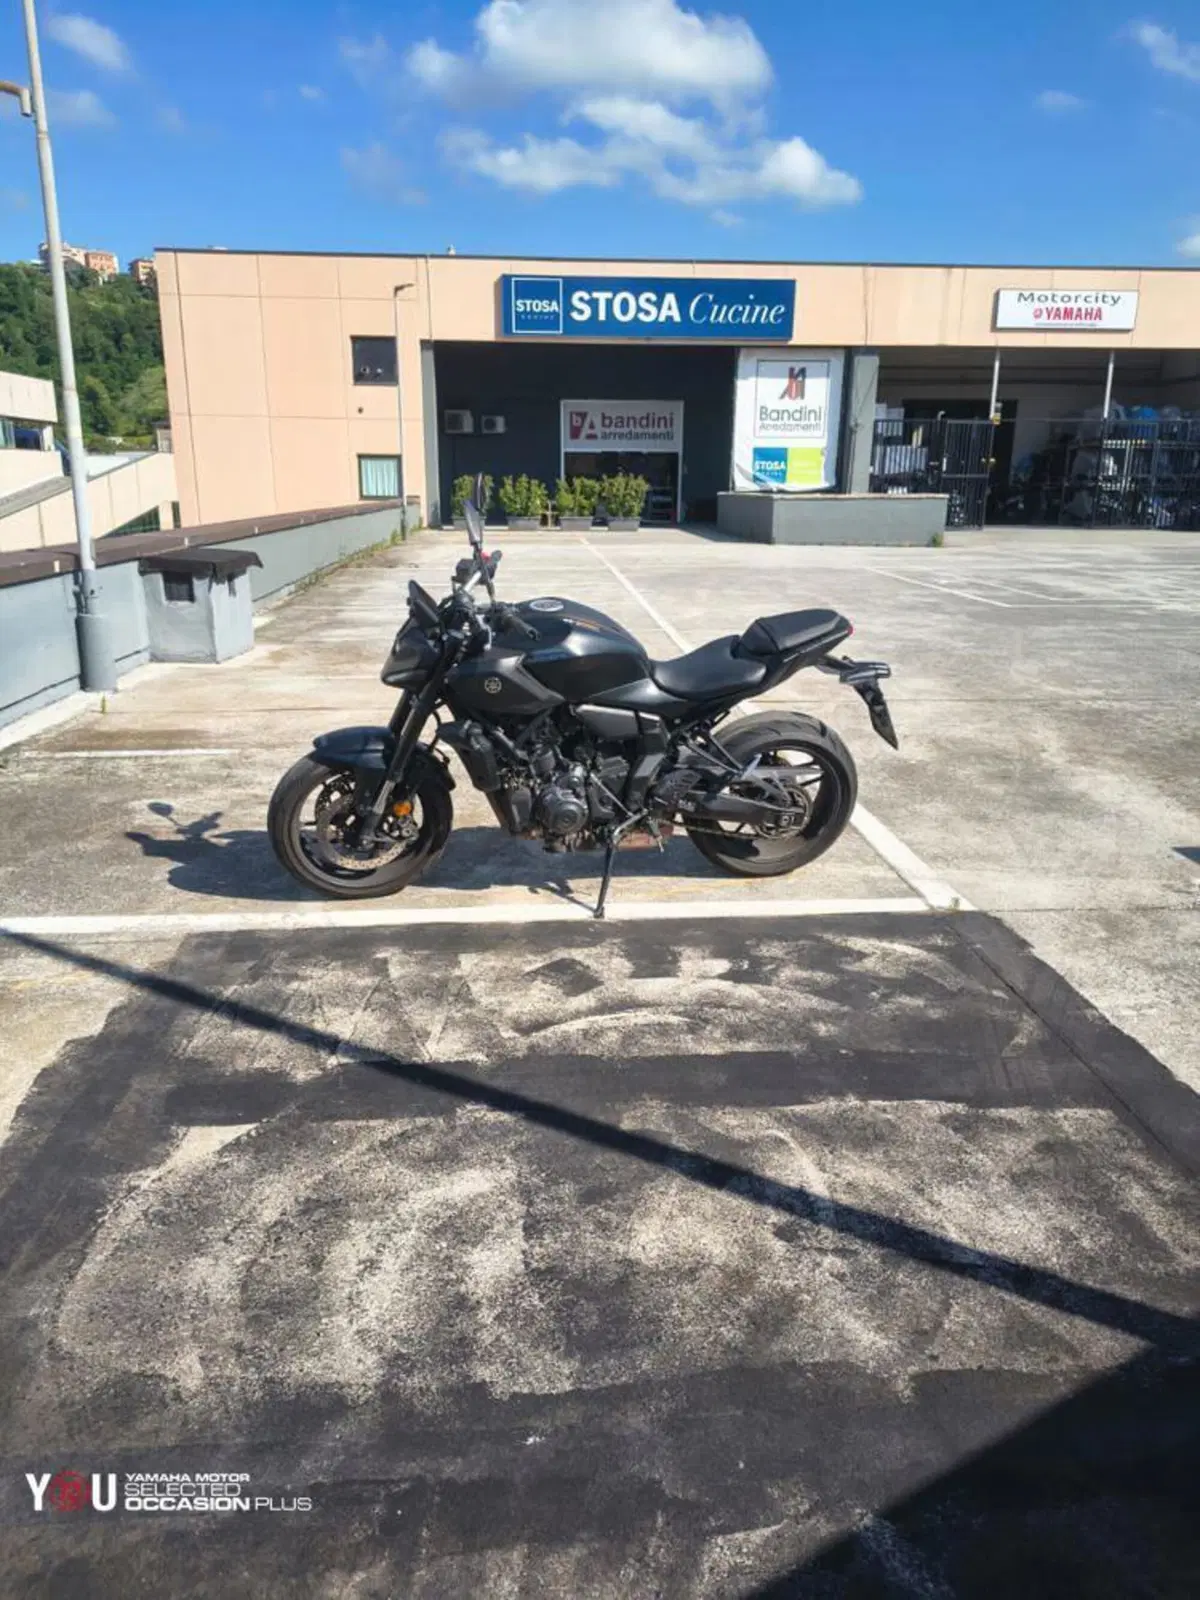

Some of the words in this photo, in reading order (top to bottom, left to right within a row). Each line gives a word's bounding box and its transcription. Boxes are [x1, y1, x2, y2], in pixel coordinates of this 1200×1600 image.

[516, 299, 559, 312] STOSA
[1017, 292, 1121, 306] Motorcity
[570, 291, 682, 322] STOSA
[689, 292, 785, 324] Cucine
[1046, 306, 1103, 321] YAMAHA
[601, 411, 674, 429] bandini
[759, 405, 822, 421] Bandini
[601, 430, 674, 440] arredamenti
[755, 460, 786, 470] STOSA
